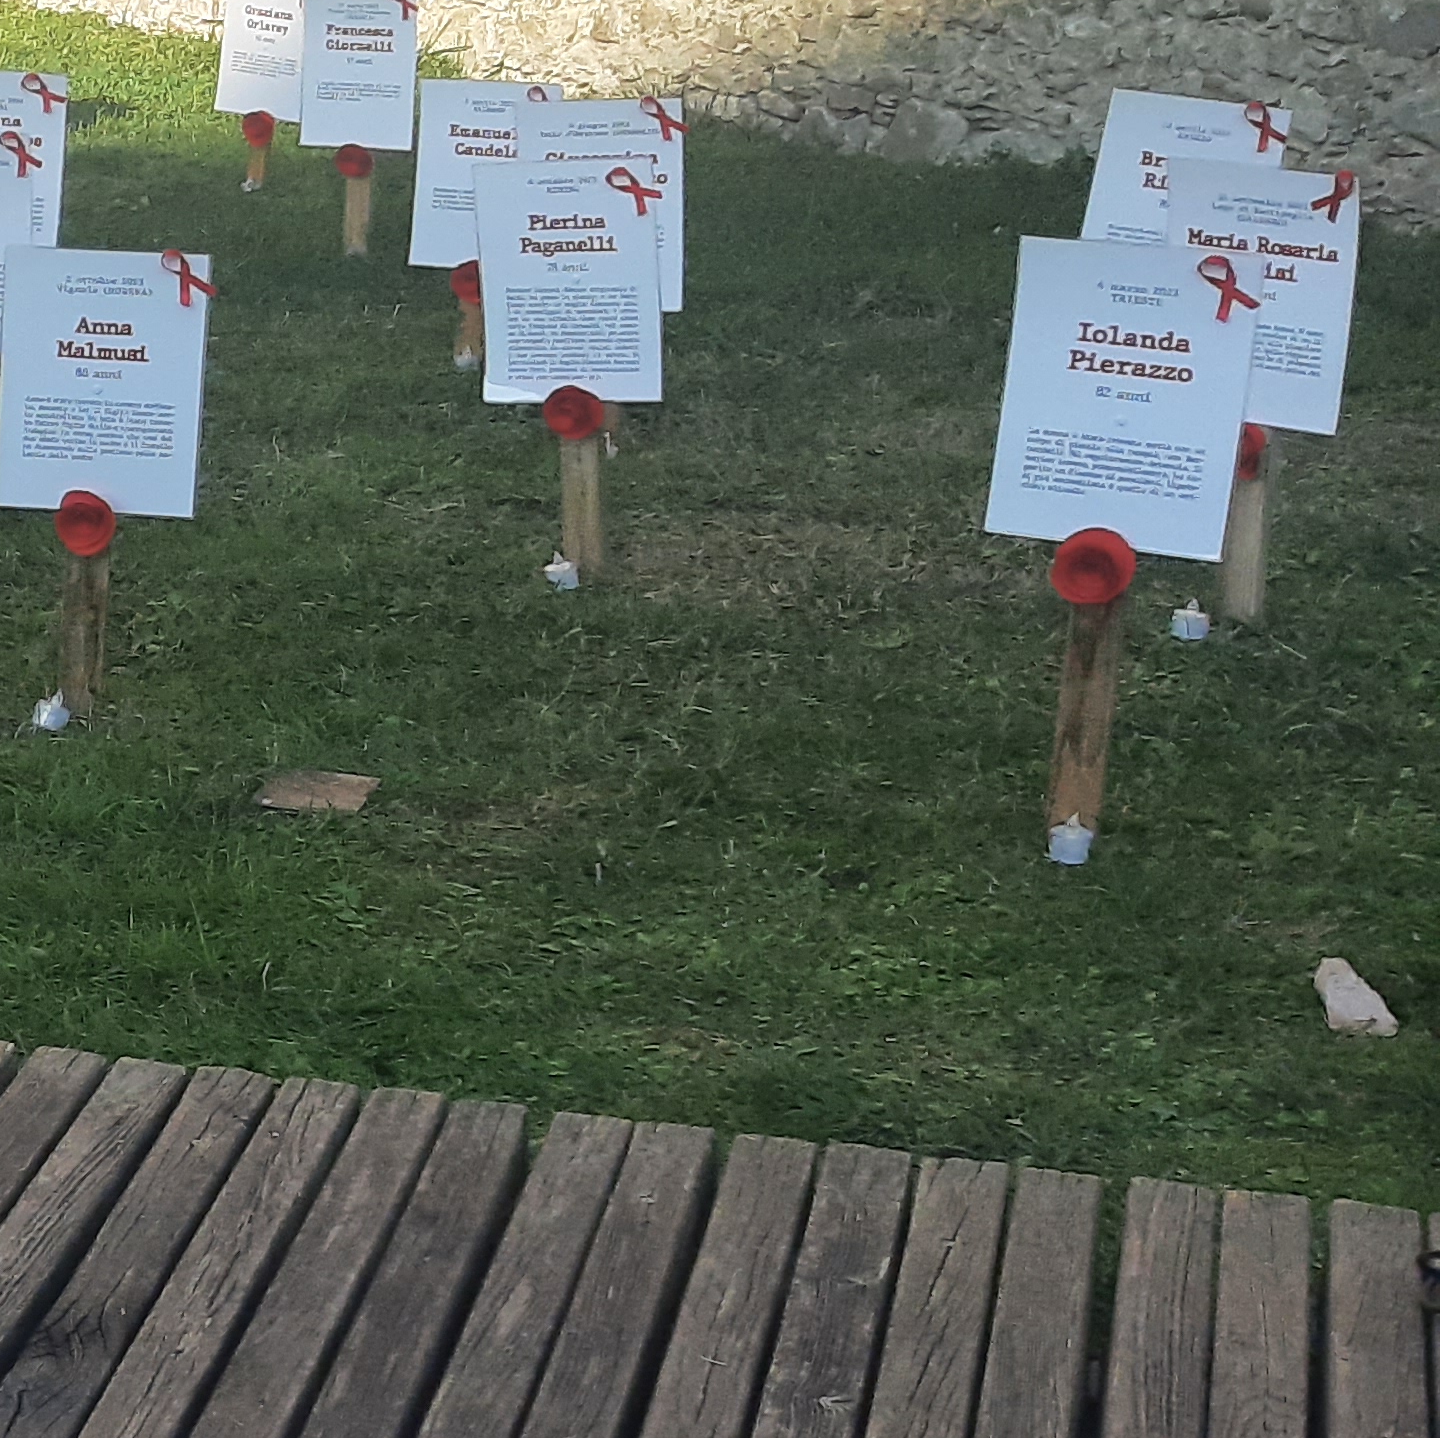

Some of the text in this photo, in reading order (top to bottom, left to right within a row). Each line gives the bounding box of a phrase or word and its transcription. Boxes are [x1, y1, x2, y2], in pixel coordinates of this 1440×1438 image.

[325, 23, 394, 37] Francesca
[527, 214, 606, 231] Pierina
[519, 235, 618, 257] Paganelli
[1187, 227, 1249, 251] Maria
[1256, 235, 1340, 263] Rosaria
[74, 316, 134, 336] Anna
[1075, 321, 1192, 354] Iolanda
[56, 339, 150, 363] Malmusi
[1065, 348, 1194, 383] Pierazzo
[1116, 390, 1153, 404] anni
